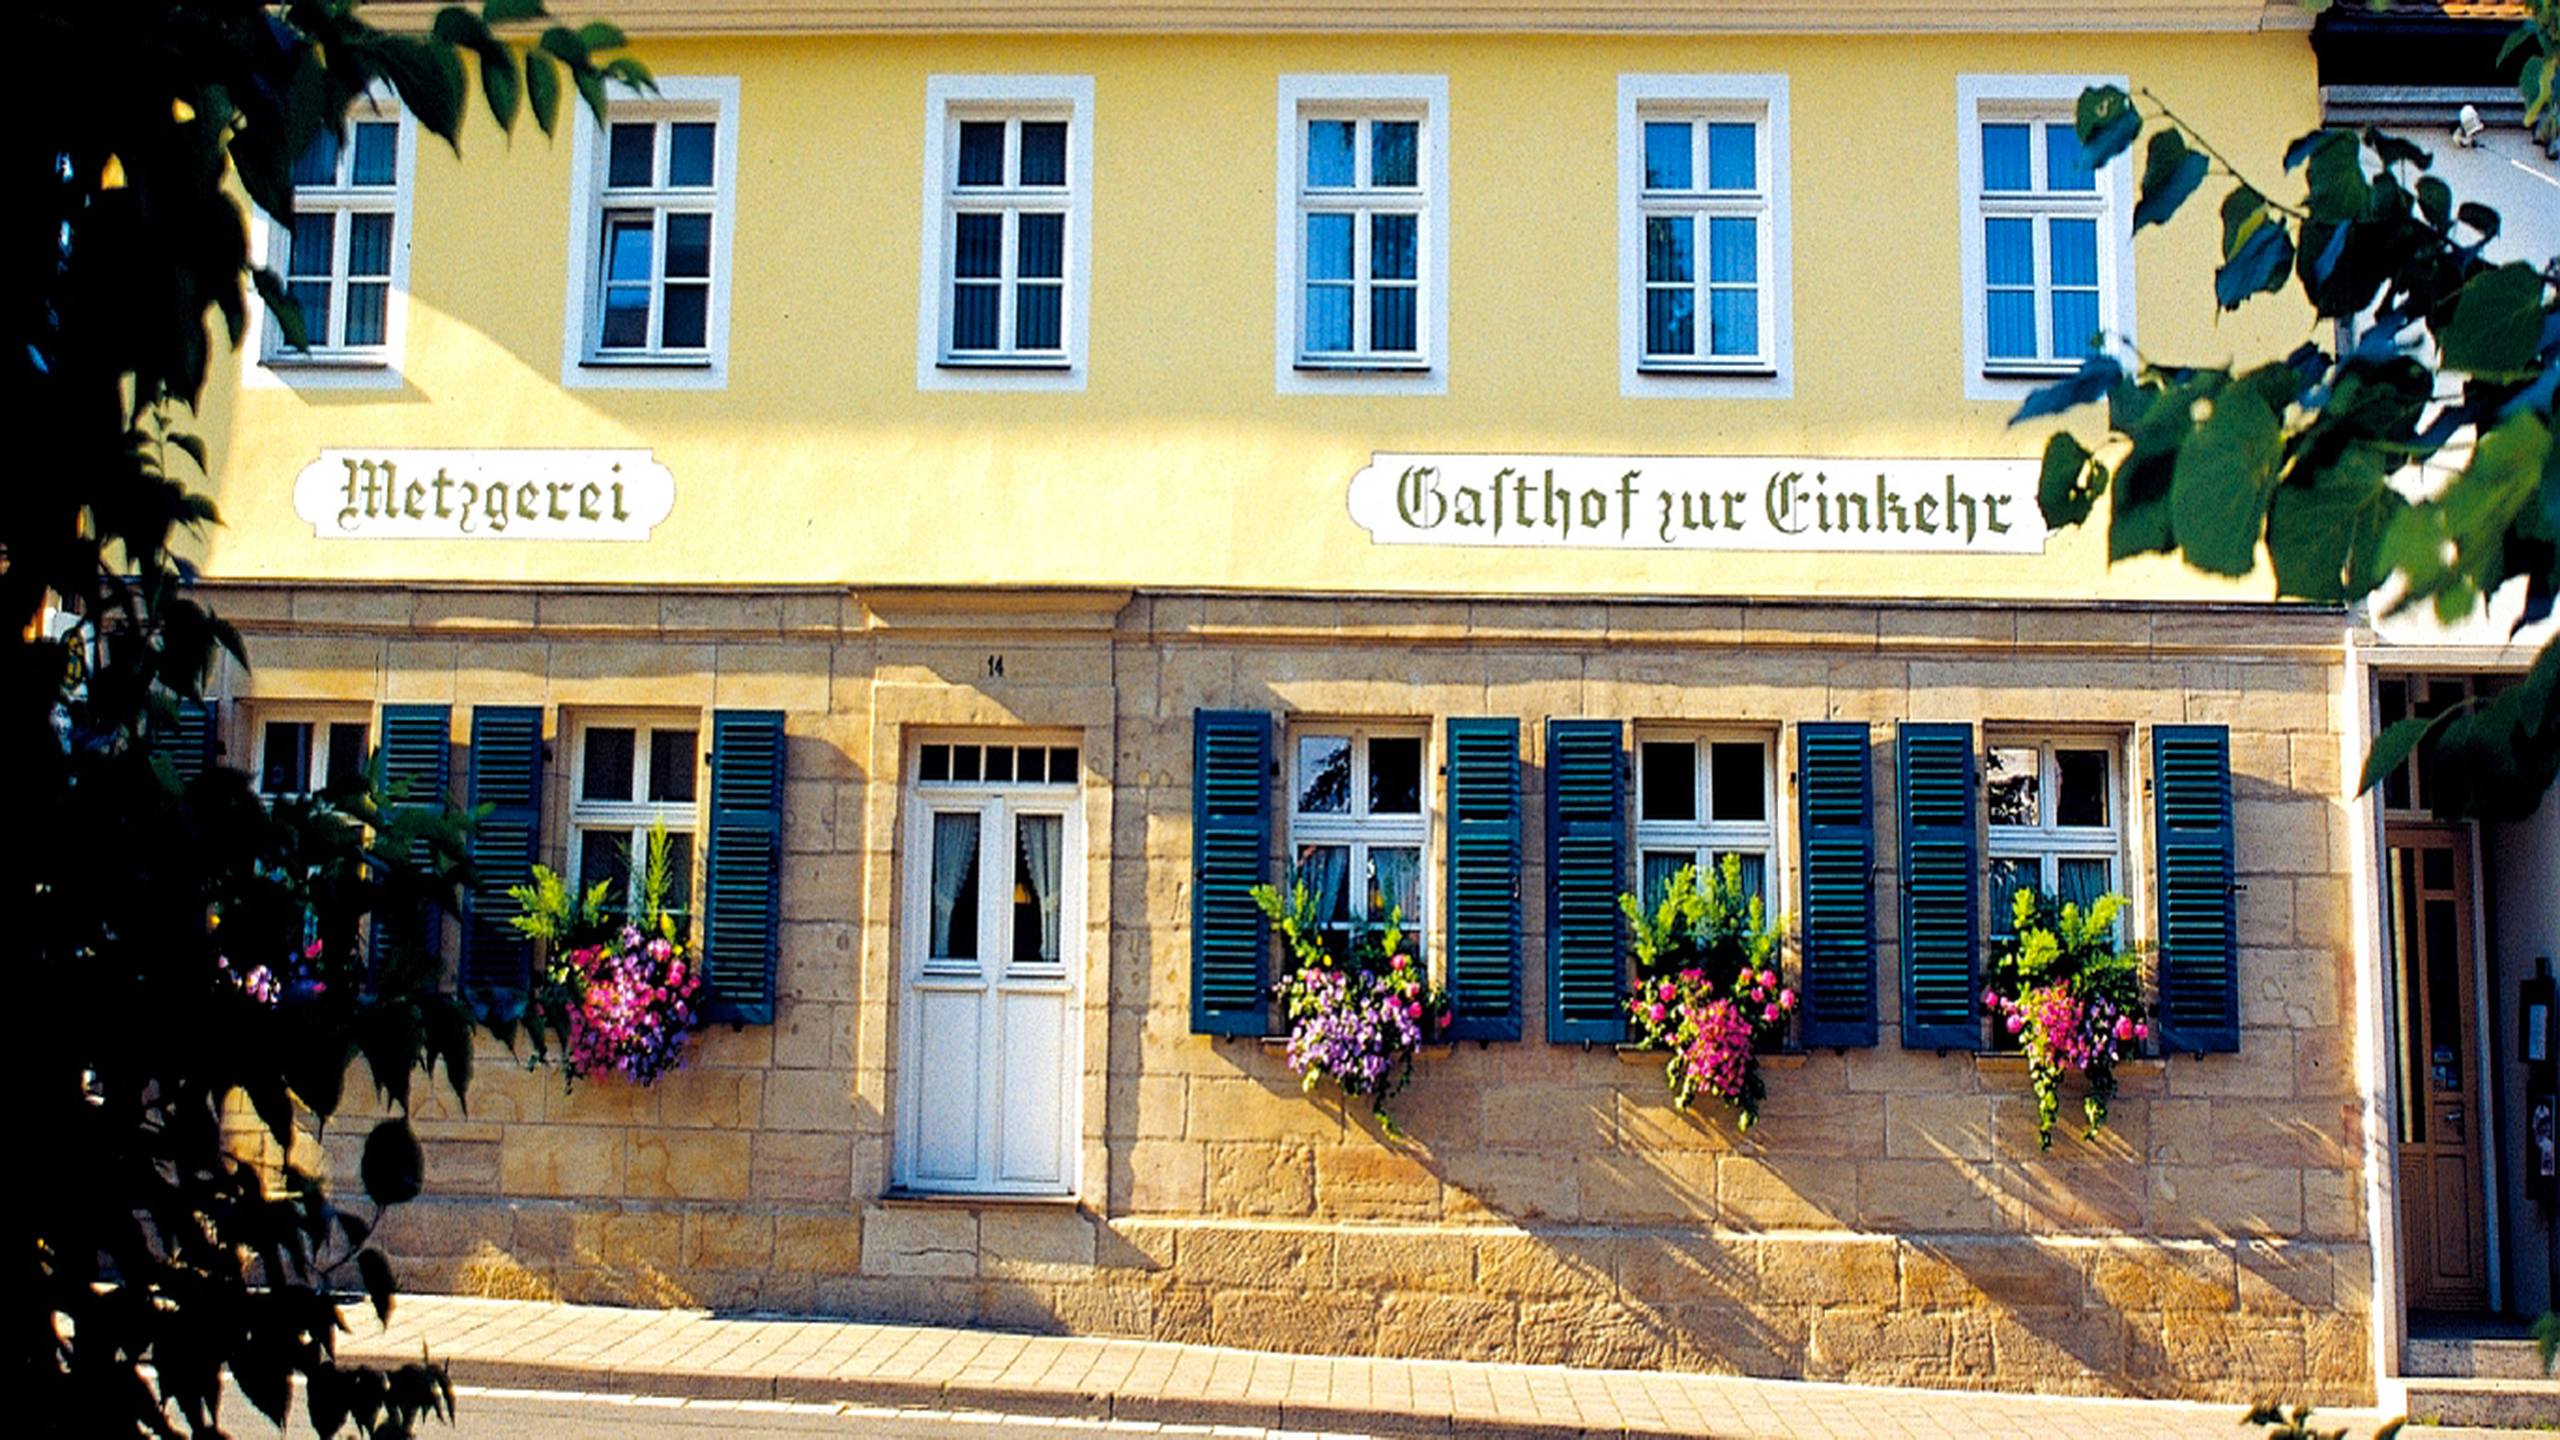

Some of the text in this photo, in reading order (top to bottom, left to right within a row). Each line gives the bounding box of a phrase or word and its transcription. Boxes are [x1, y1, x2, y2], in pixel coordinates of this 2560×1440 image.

[337, 458, 631, 533] Metzgerei
[1657, 489, 1747, 543] zur
[1765, 468, 2013, 544] Einkehr
[988, 655, 1004, 676] 14
